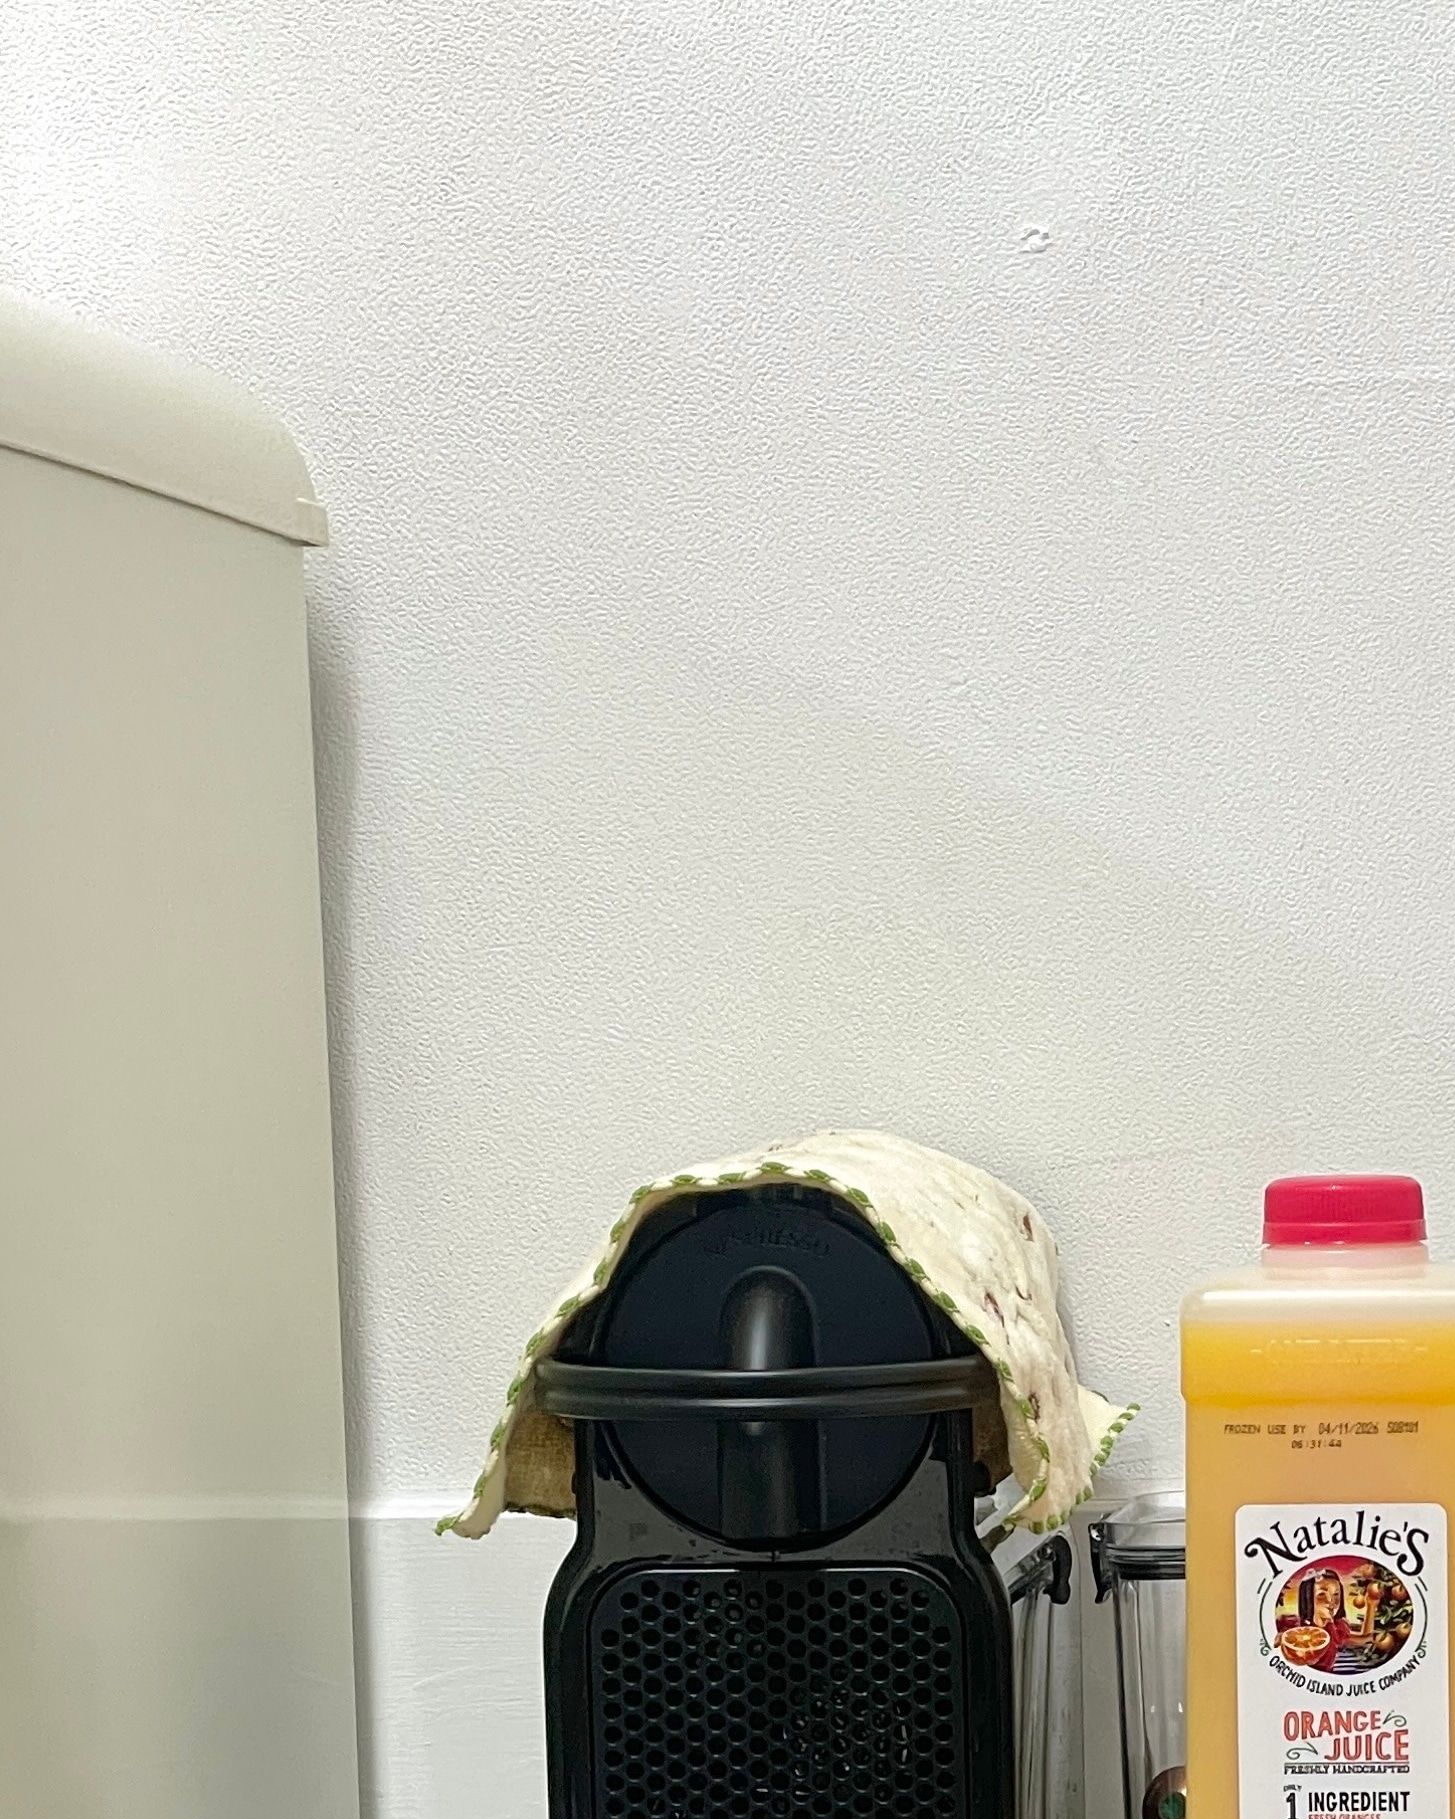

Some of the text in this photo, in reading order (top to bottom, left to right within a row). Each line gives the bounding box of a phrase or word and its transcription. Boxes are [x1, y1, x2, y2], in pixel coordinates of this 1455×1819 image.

[1224, 1424, 1261, 1434] FROZEN
[1268, 1424, 1286, 1434] USE
[1293, 1424, 1305, 1434] BY
[1269, 1655, 1420, 1697] ORCHID ISLAND JUICE COMPANY
[1284, 1710, 1381, 1741] ORANGE
[1324, 1729, 1409, 1761] JUICE
[1284, 1765, 1410, 1774] FRESHLY HANDCRAFTED
[1308, 1792, 1410, 1812] INGREDIENT
